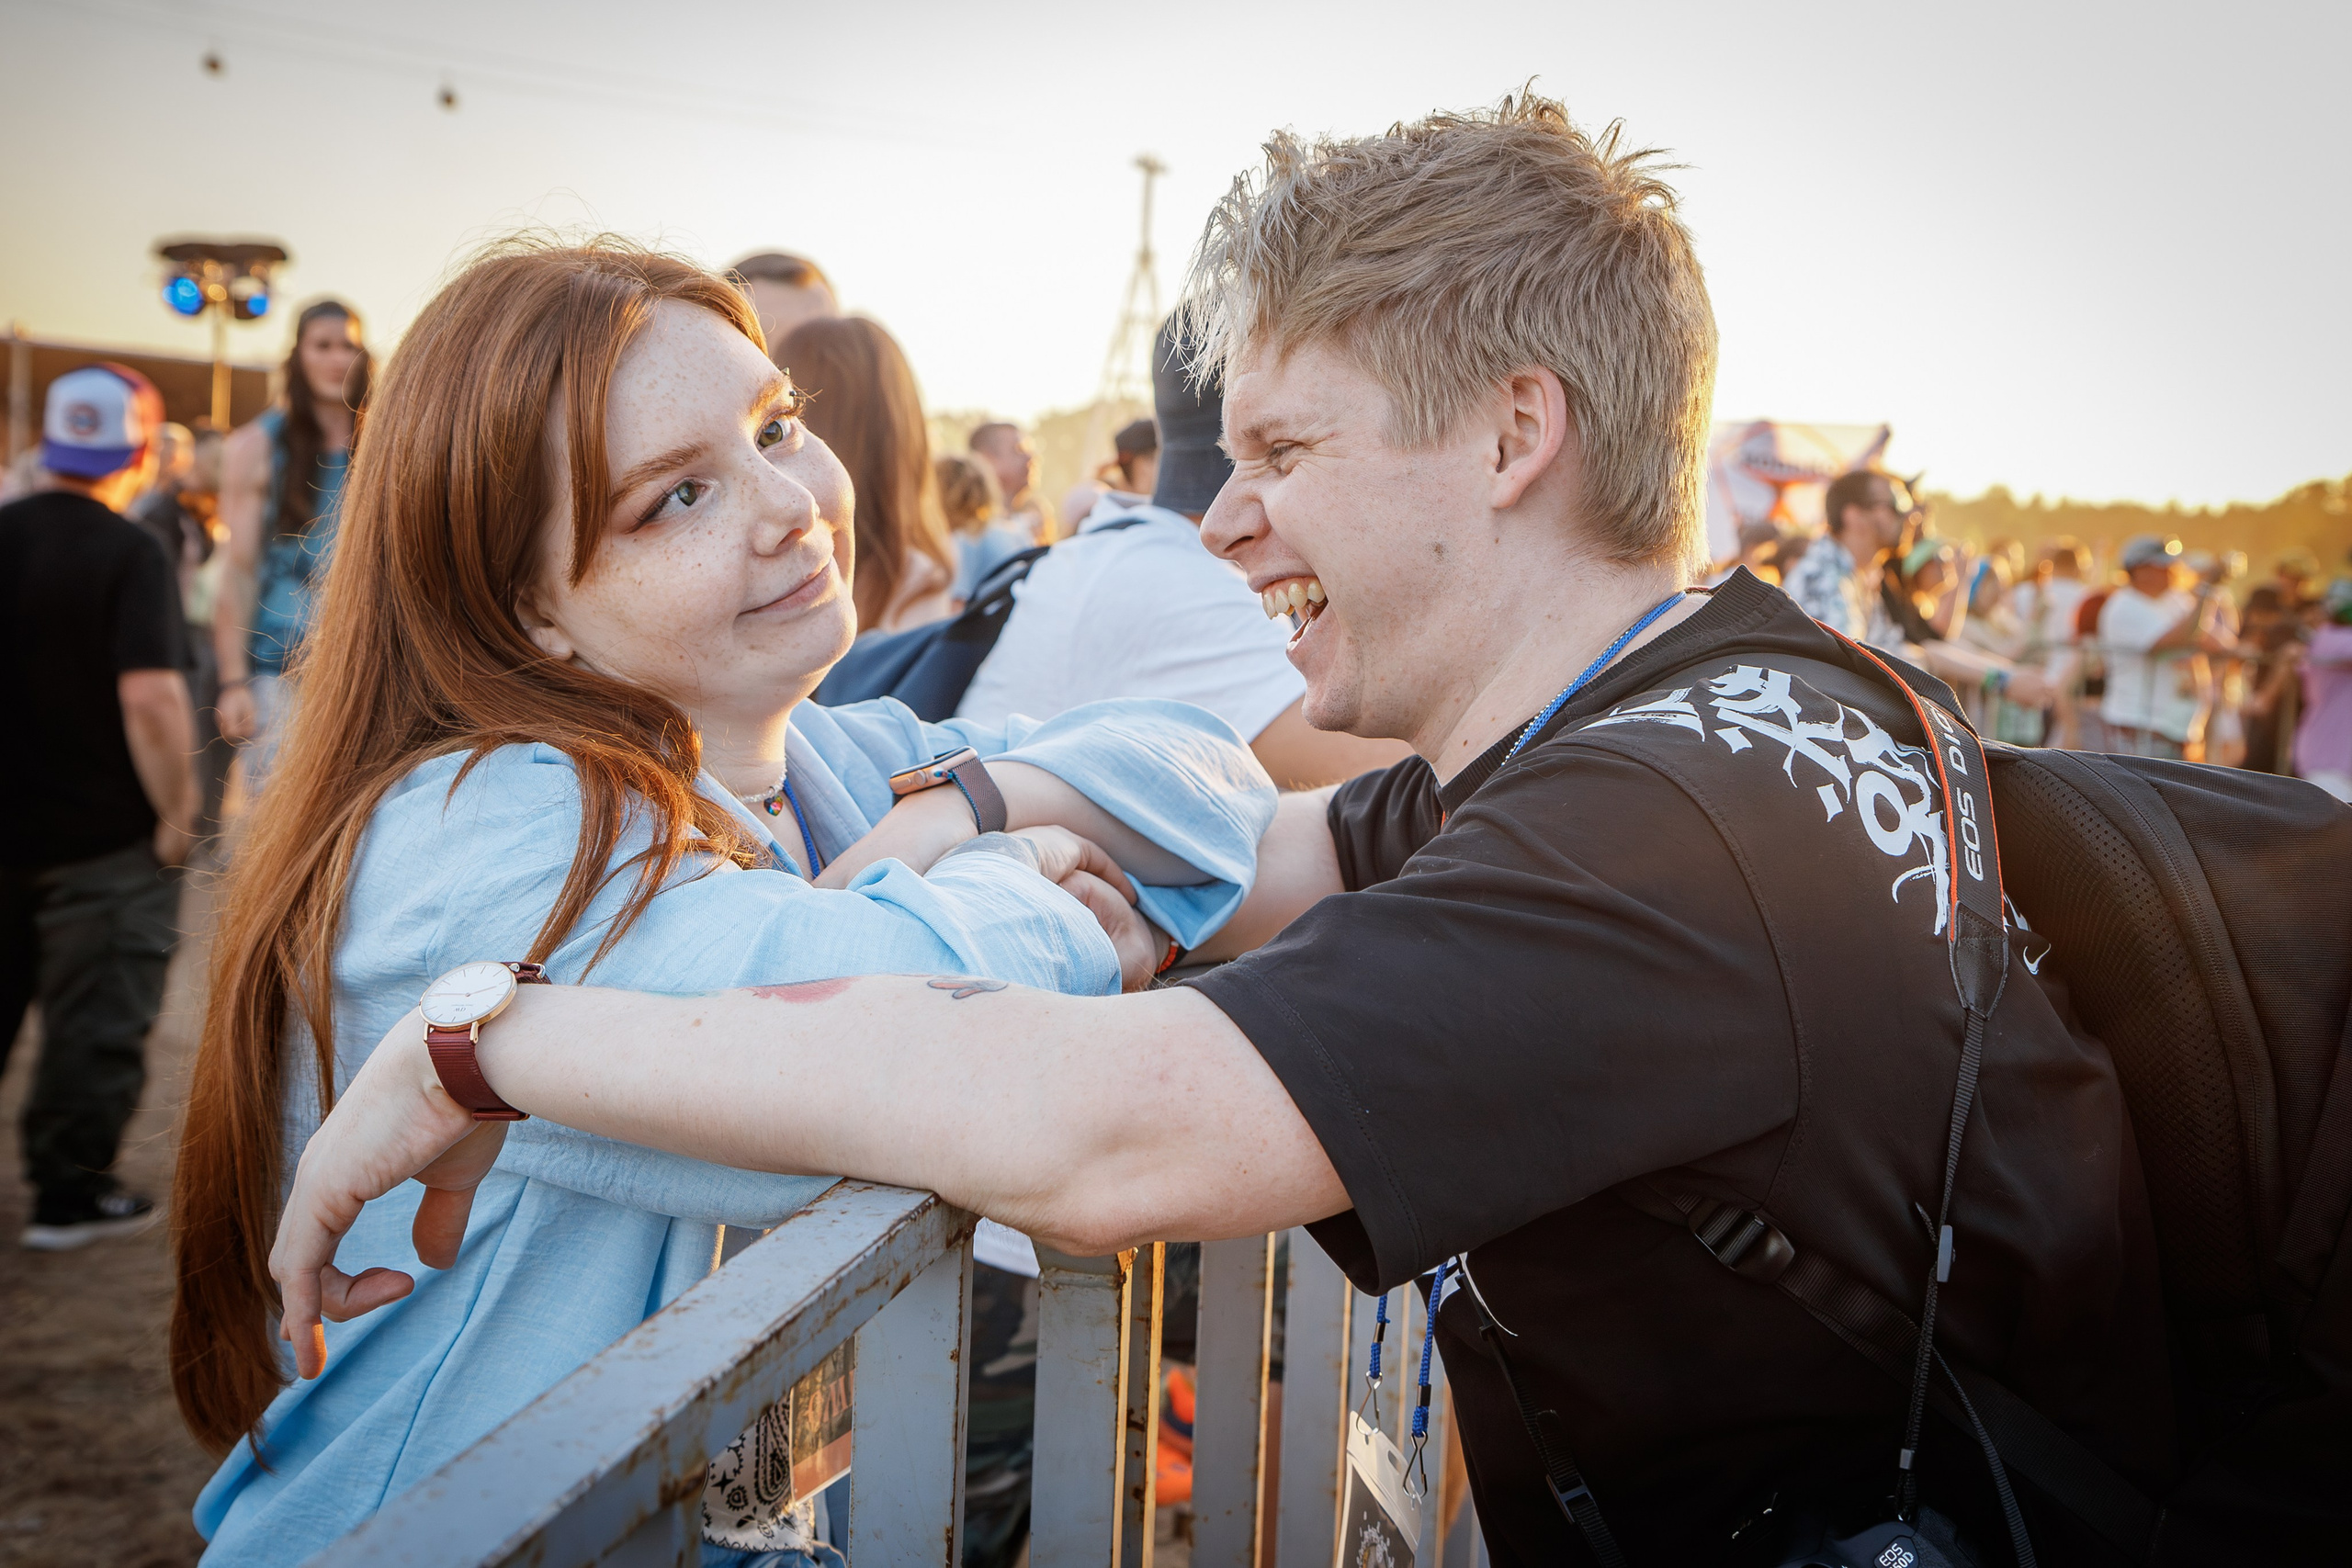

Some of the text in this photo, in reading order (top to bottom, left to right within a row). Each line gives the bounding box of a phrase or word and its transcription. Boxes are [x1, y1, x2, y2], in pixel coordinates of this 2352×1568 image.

[1956, 787, 1984, 882] EOS
[1879, 1543, 1903, 1566] EOS
[1889, 1551, 1914, 1568] 50D
